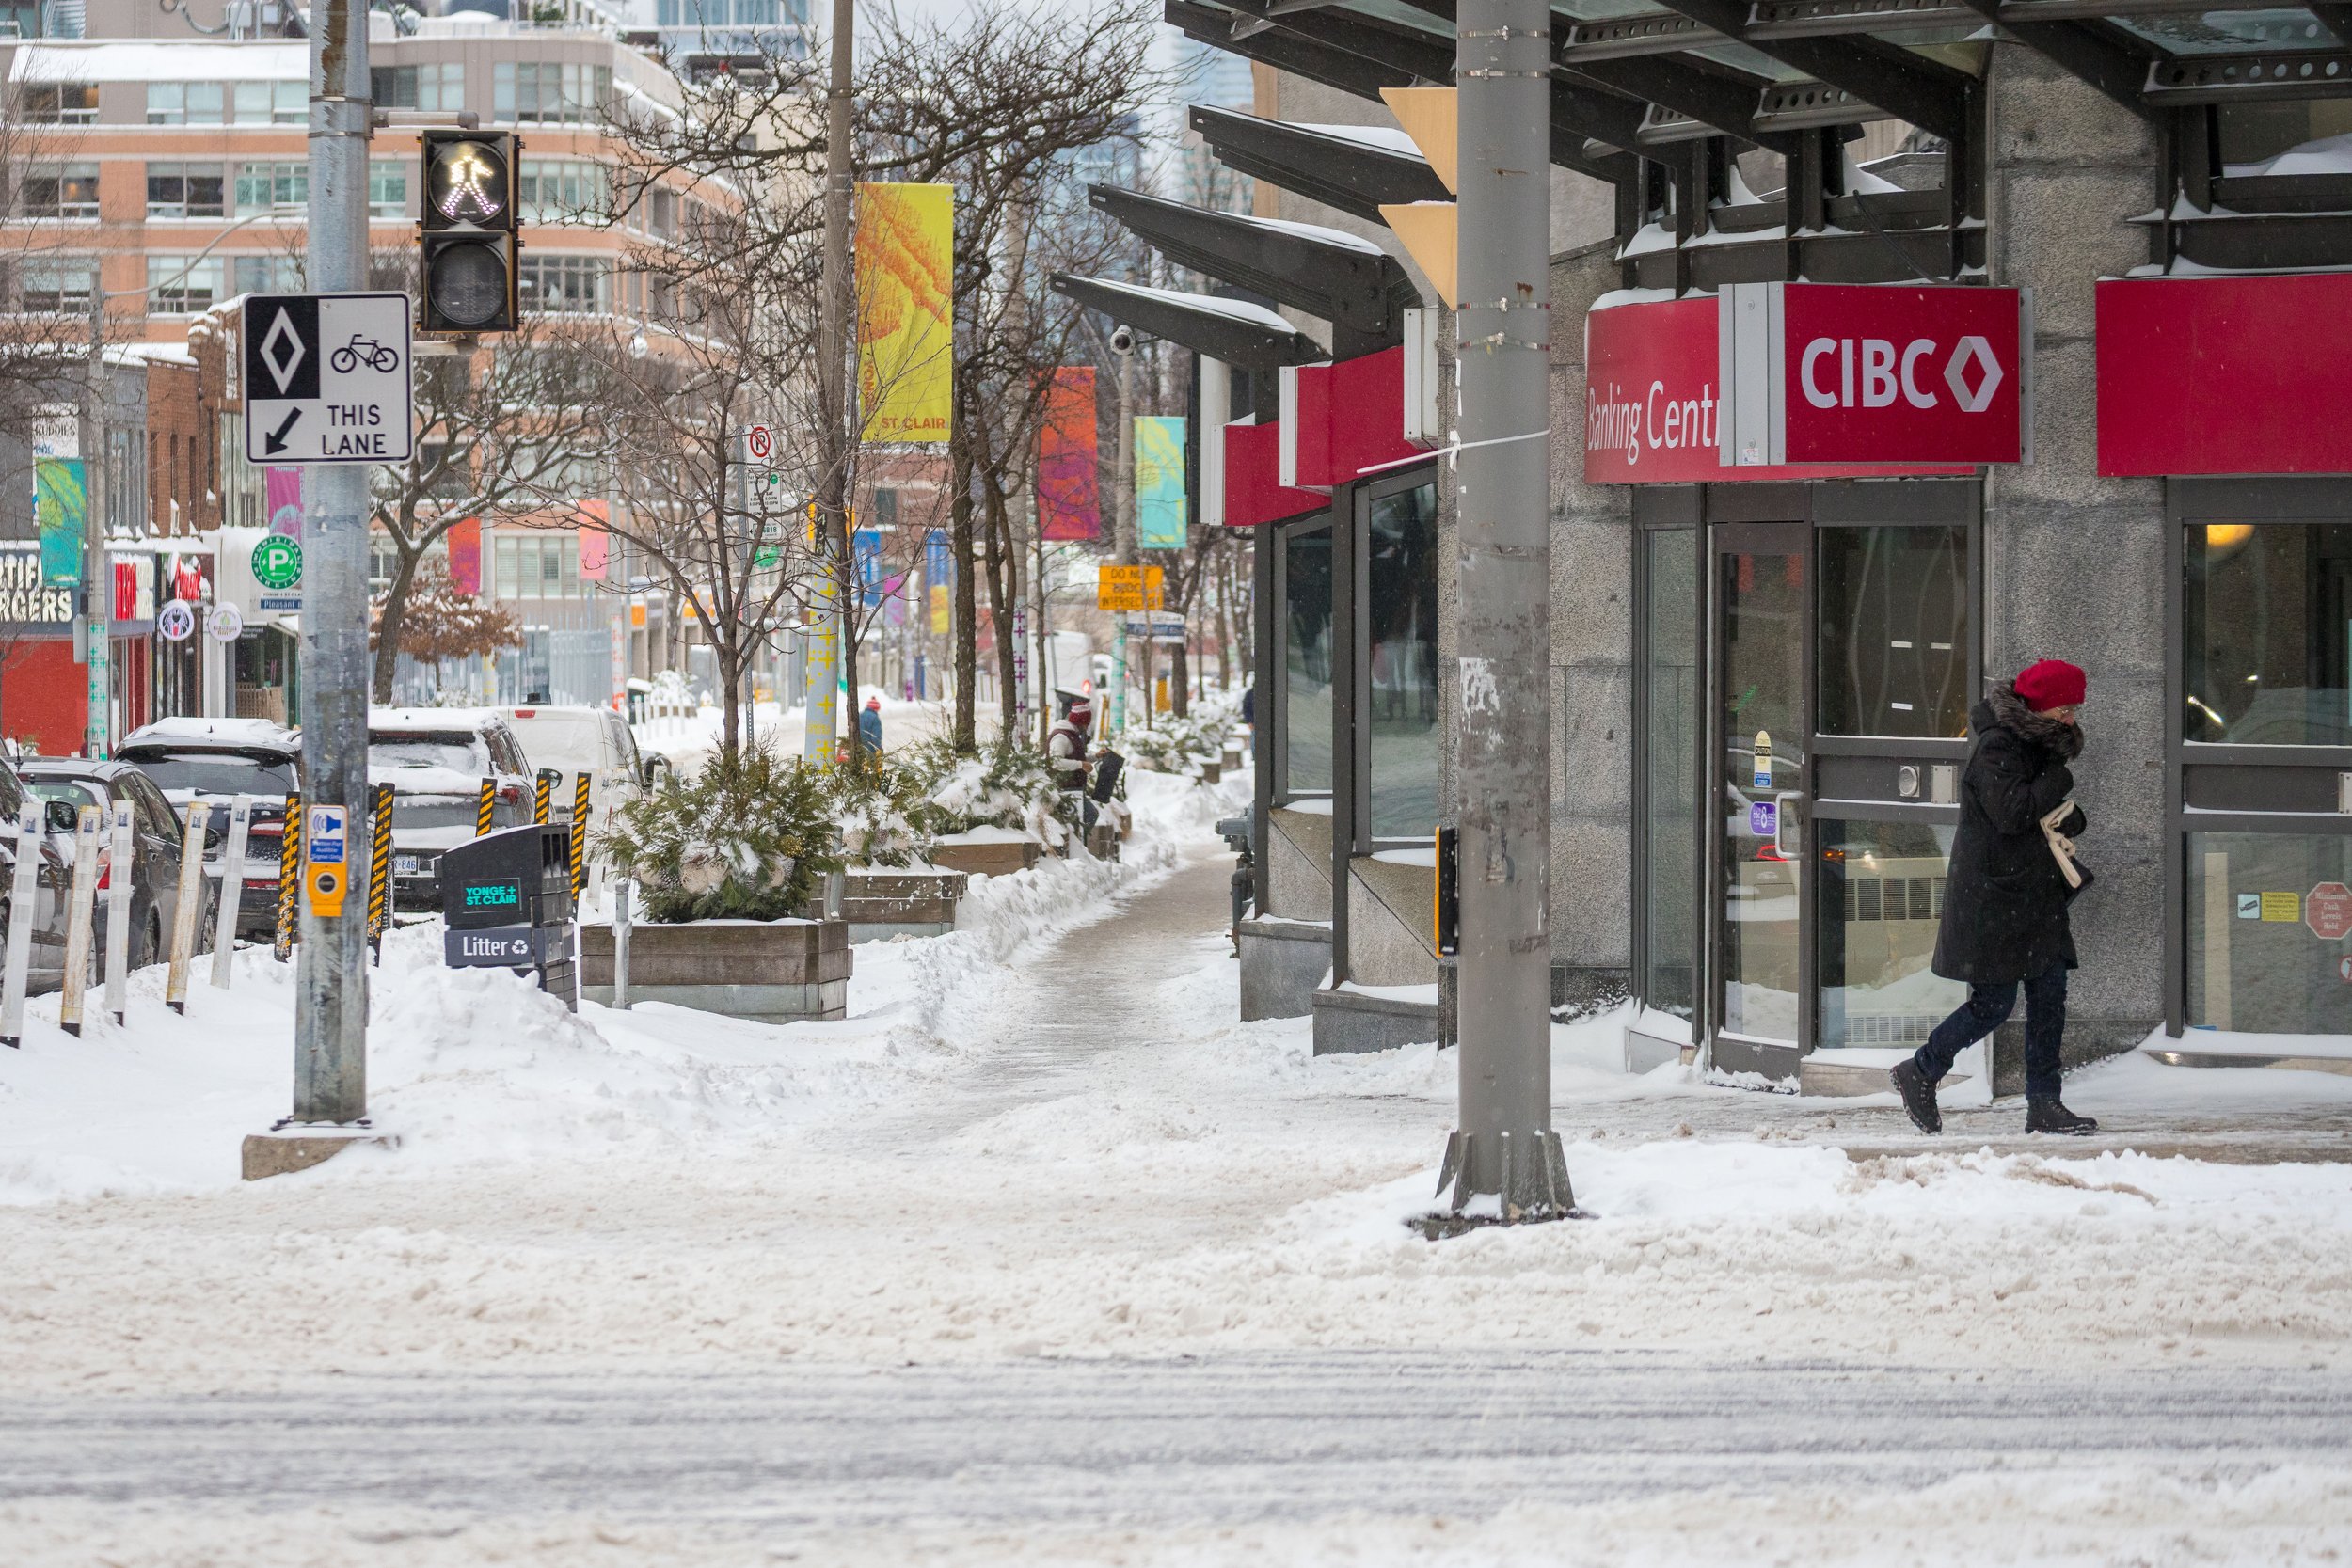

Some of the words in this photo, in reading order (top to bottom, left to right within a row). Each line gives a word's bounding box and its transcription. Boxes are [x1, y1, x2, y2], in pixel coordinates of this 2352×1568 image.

[1801, 337, 1939, 409] CIBC
[326, 404, 381, 426] THIS
[903, 417, 946, 429] CLAIR
[1587, 382, 1643, 466] Banking
[322, 433, 387, 455] LANE
[269, 548, 289, 571] P
[253, 567, 301, 589] PARKING
[1111, 568, 1125, 579] DO
[264, 598, 295, 609] Pleasant
[466, 886, 506, 896] YONGE
[2317, 892, 2348, 901] Minimum
[466, 896, 481, 906] ST.
[482, 895, 517, 905] CLAIR
[2323, 902, 2340, 911] Cash
[2321, 912, 2342, 921] Levels
[463, 936, 508, 957] Litter
